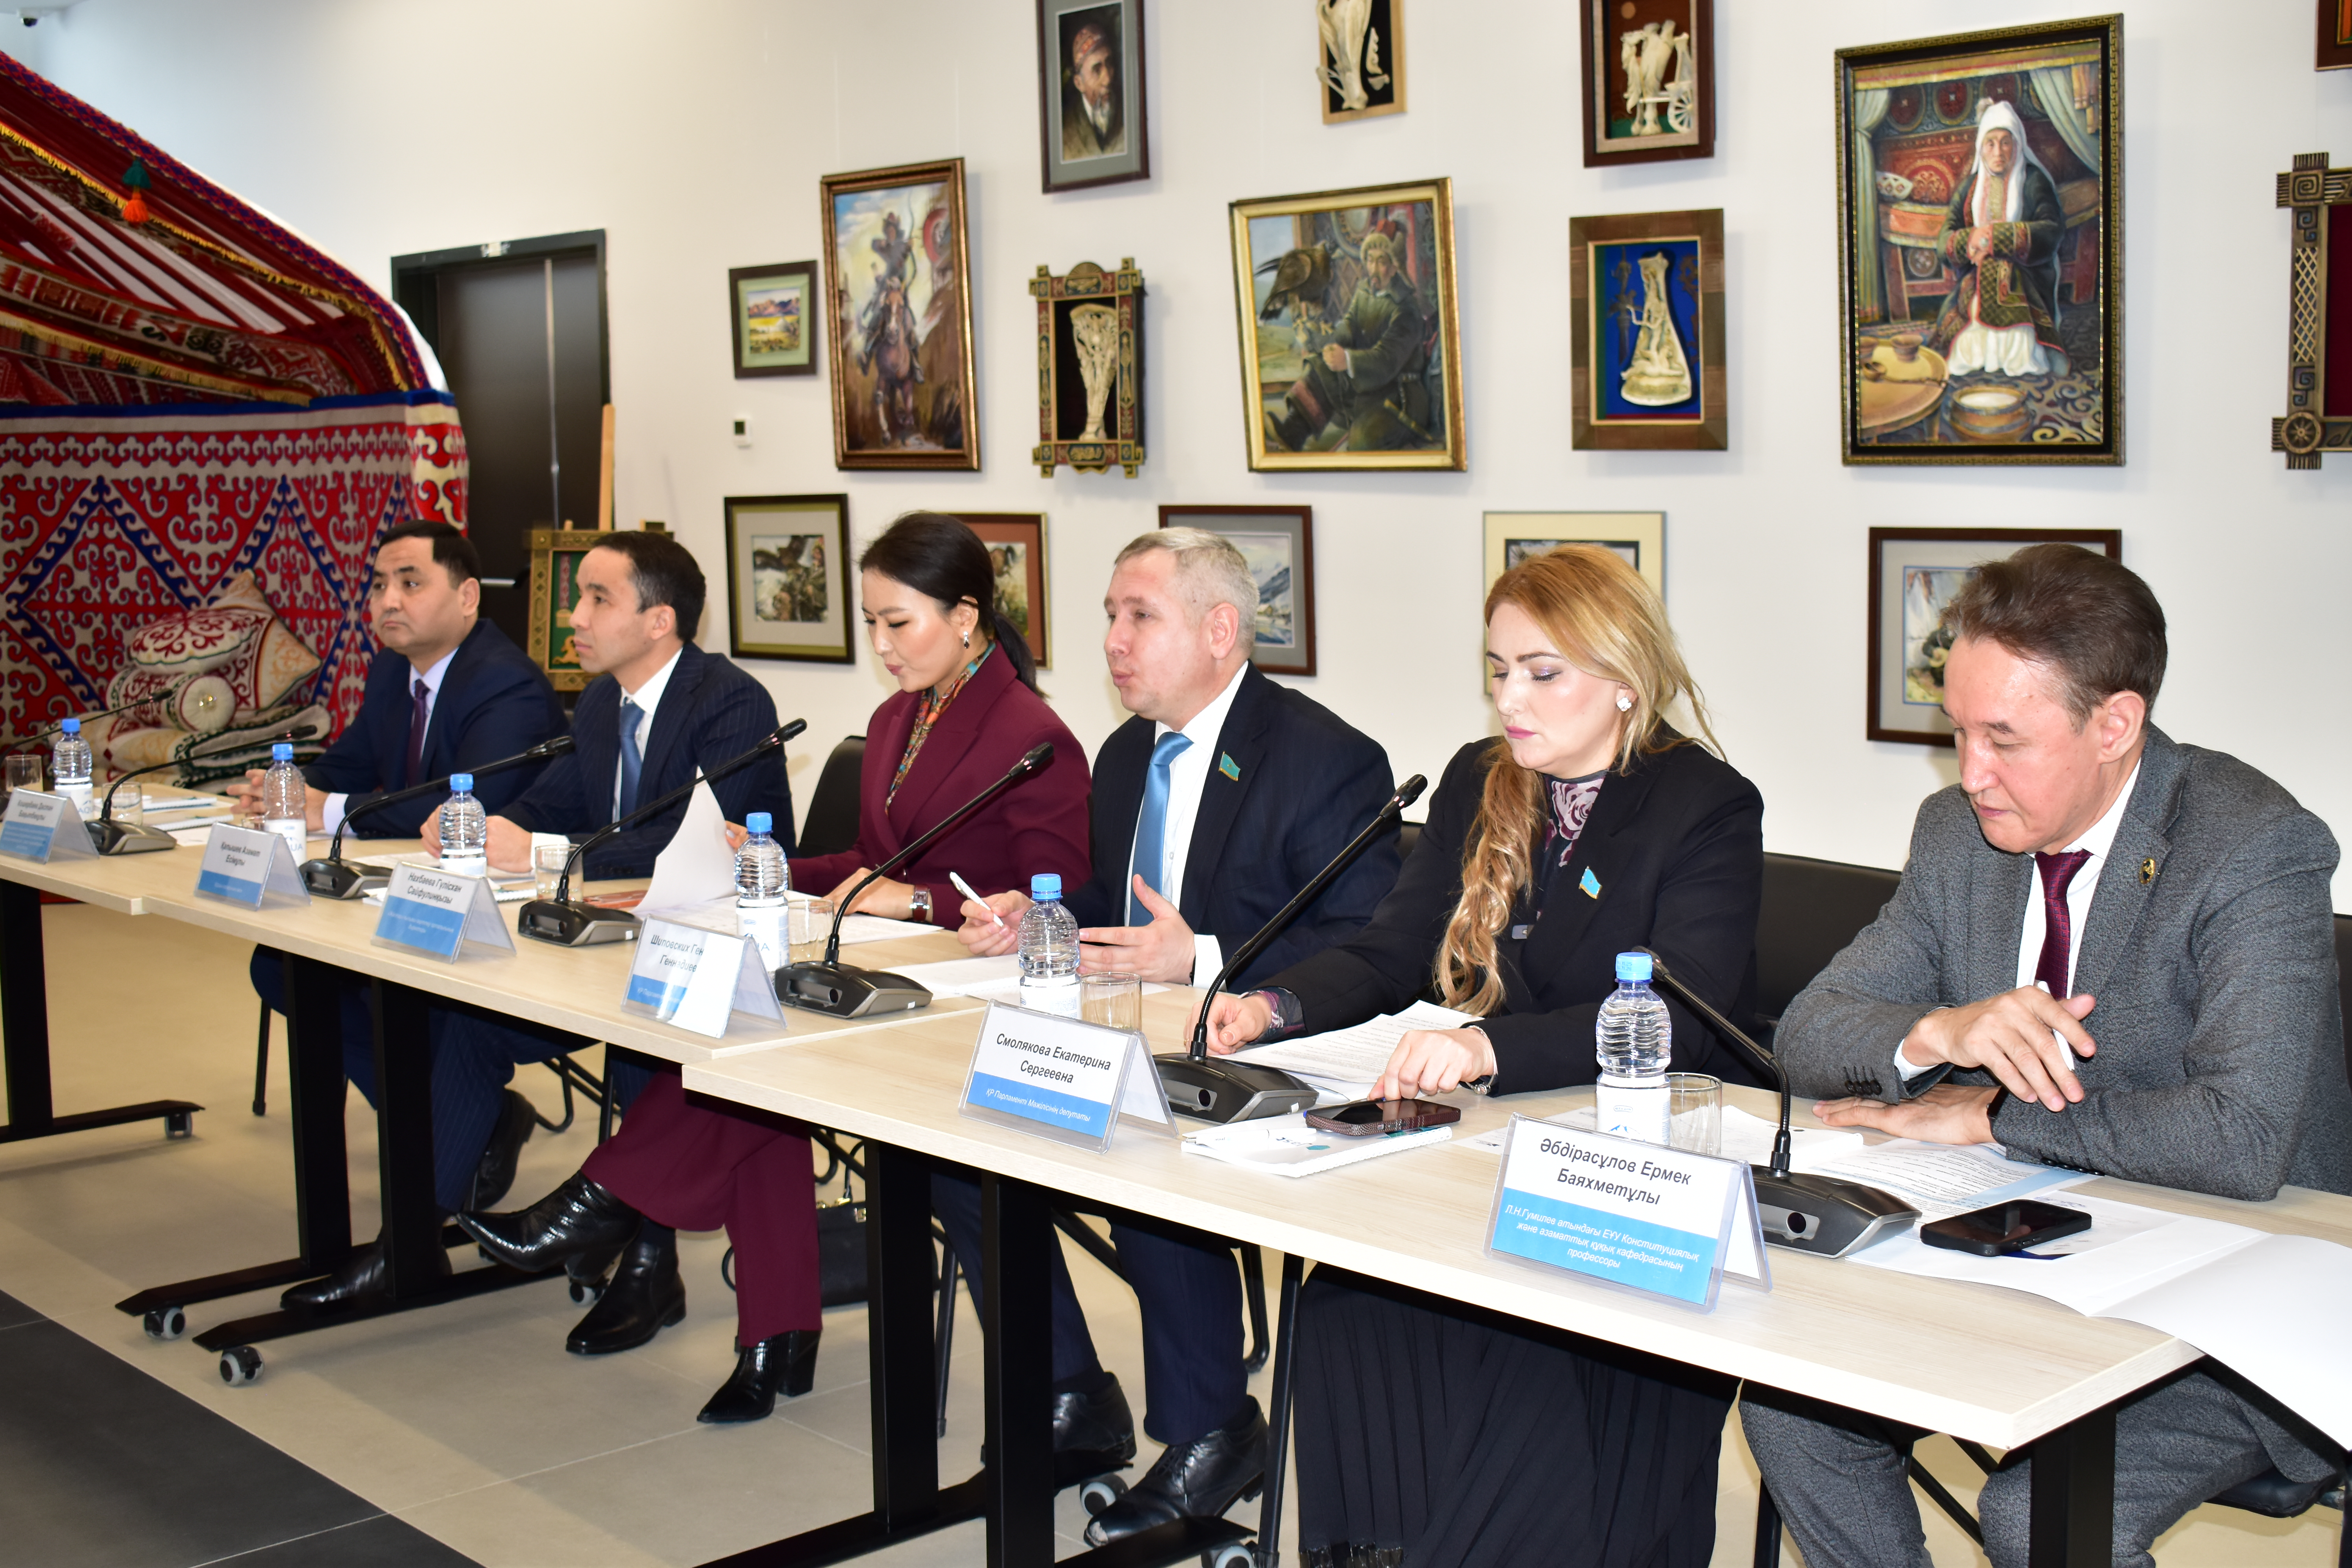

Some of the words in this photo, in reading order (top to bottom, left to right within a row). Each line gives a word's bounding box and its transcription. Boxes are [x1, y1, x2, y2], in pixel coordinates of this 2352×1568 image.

[651, 935, 690, 952] Шиповских
[660, 955, 697, 972] Геннадиев
[996, 1033, 1051, 1056] Смолякова
[1053, 1046, 1111, 1071] Екатерина
[1020, 1060, 1074, 1083] Сергеевна
[986, 1088, 995, 1097] ҚР
[995, 1091, 1028, 1105] Парламенті
[1028, 1099, 1059, 1114] Мәжілісінің
[1059, 1107, 1091, 1122] депутаты
[1540, 1138, 1637, 1172] Әбдірасұлов
[1641, 1160, 1692, 1185] Ермек
[1557, 1168, 1661, 1205] Баяхметұлы
[1505, 1204, 1556, 1225] Л.Н.Гумилев
[1557, 1220, 1601, 1236] атындағы
[1602, 1229, 1621, 1240] ЕҰУ
[1621, 1234, 1700, 1262] Конституциялық
[1516, 1222, 1538, 1233] және
[1539, 1228, 1590, 1248] азаматтық
[1590, 1241, 1616, 1254] құқық
[1616, 1248, 1683, 1272] кафедрасының
[1567, 1248, 1621, 1268] профессоры
